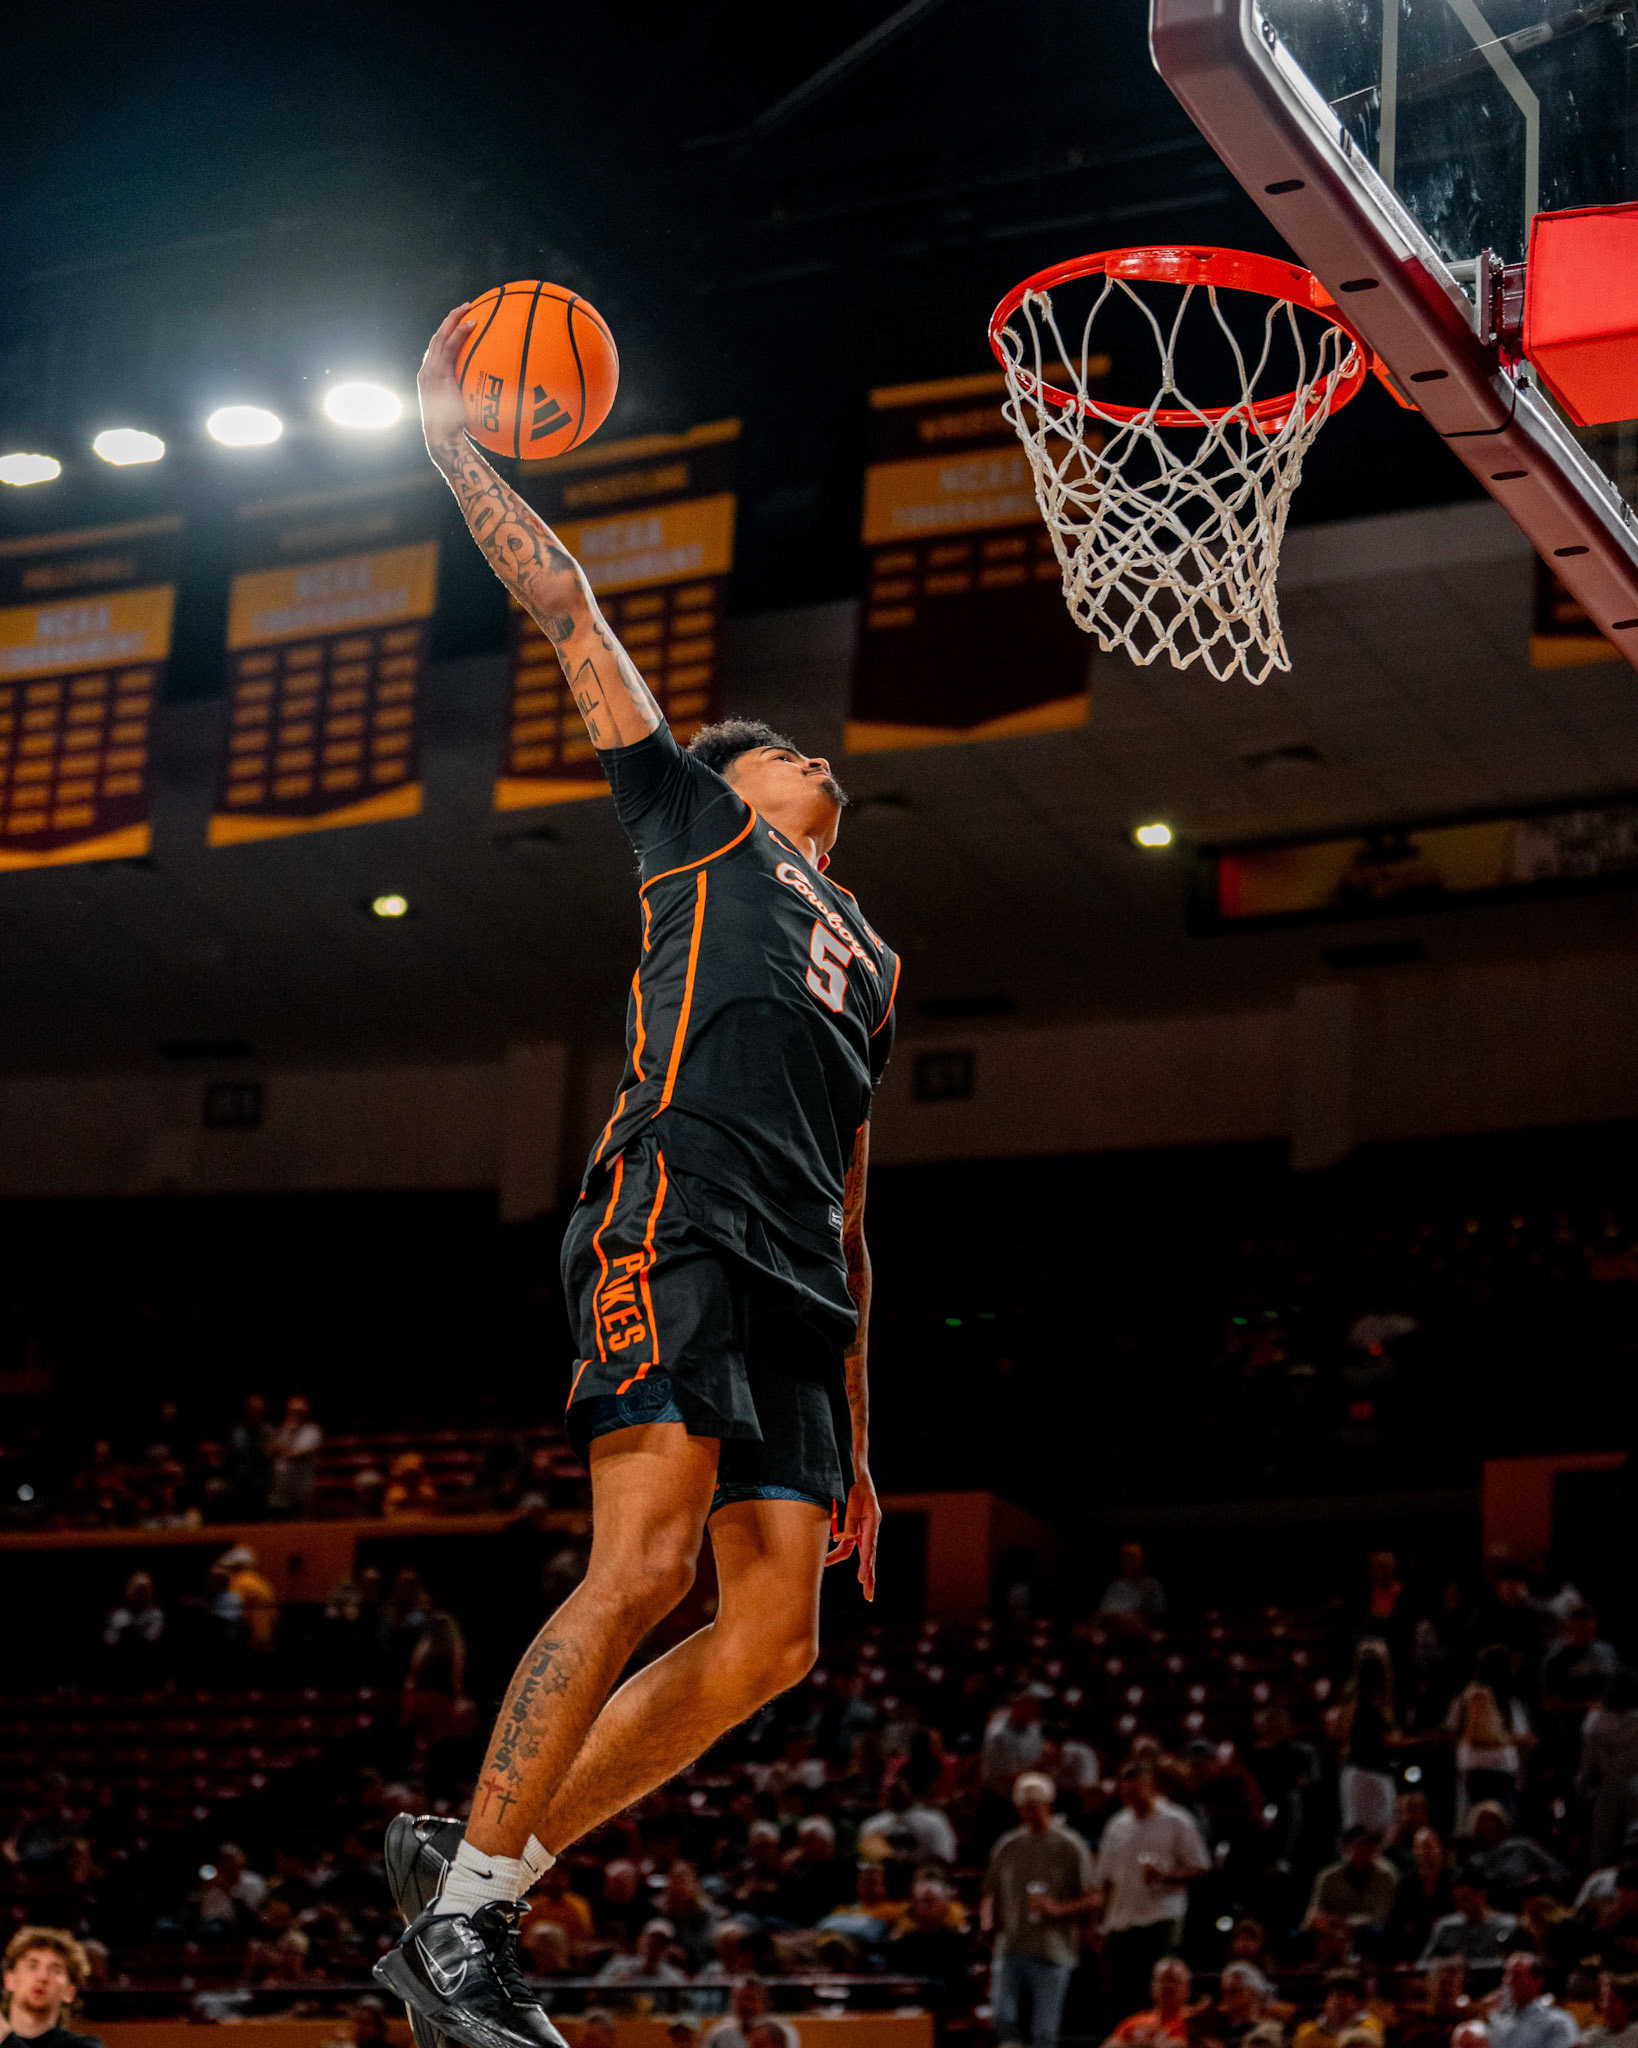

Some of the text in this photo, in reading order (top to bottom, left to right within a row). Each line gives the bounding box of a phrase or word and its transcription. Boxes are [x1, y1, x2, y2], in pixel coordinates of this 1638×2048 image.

[483, 374, 505, 433] PRO
[775, 861, 879, 977] Cowboys
[805, 918, 855, 1013] 5
